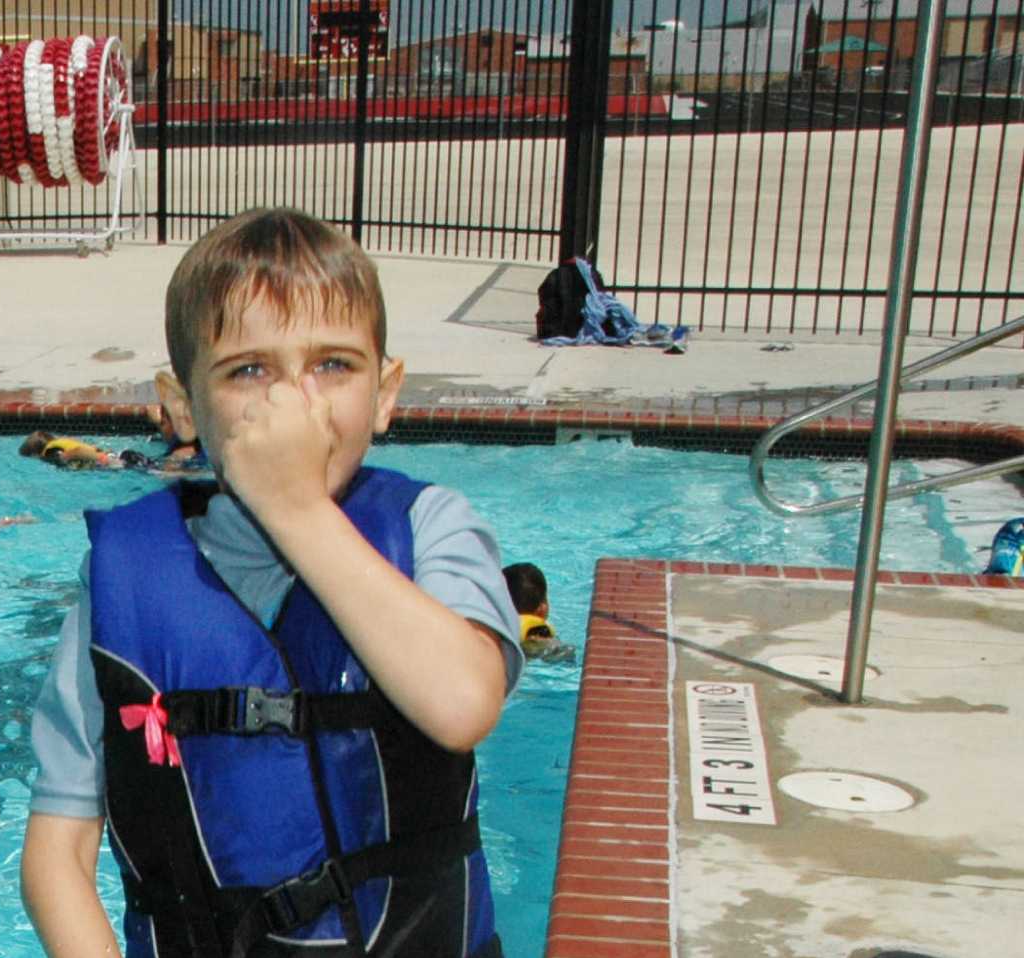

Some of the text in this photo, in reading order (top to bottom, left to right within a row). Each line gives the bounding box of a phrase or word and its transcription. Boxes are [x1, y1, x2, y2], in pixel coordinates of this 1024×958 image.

[700, 735, 753, 752] IN
[702, 759, 754, 769] 3
[703, 776, 759, 797] FT
[706, 803, 762, 815] 4
